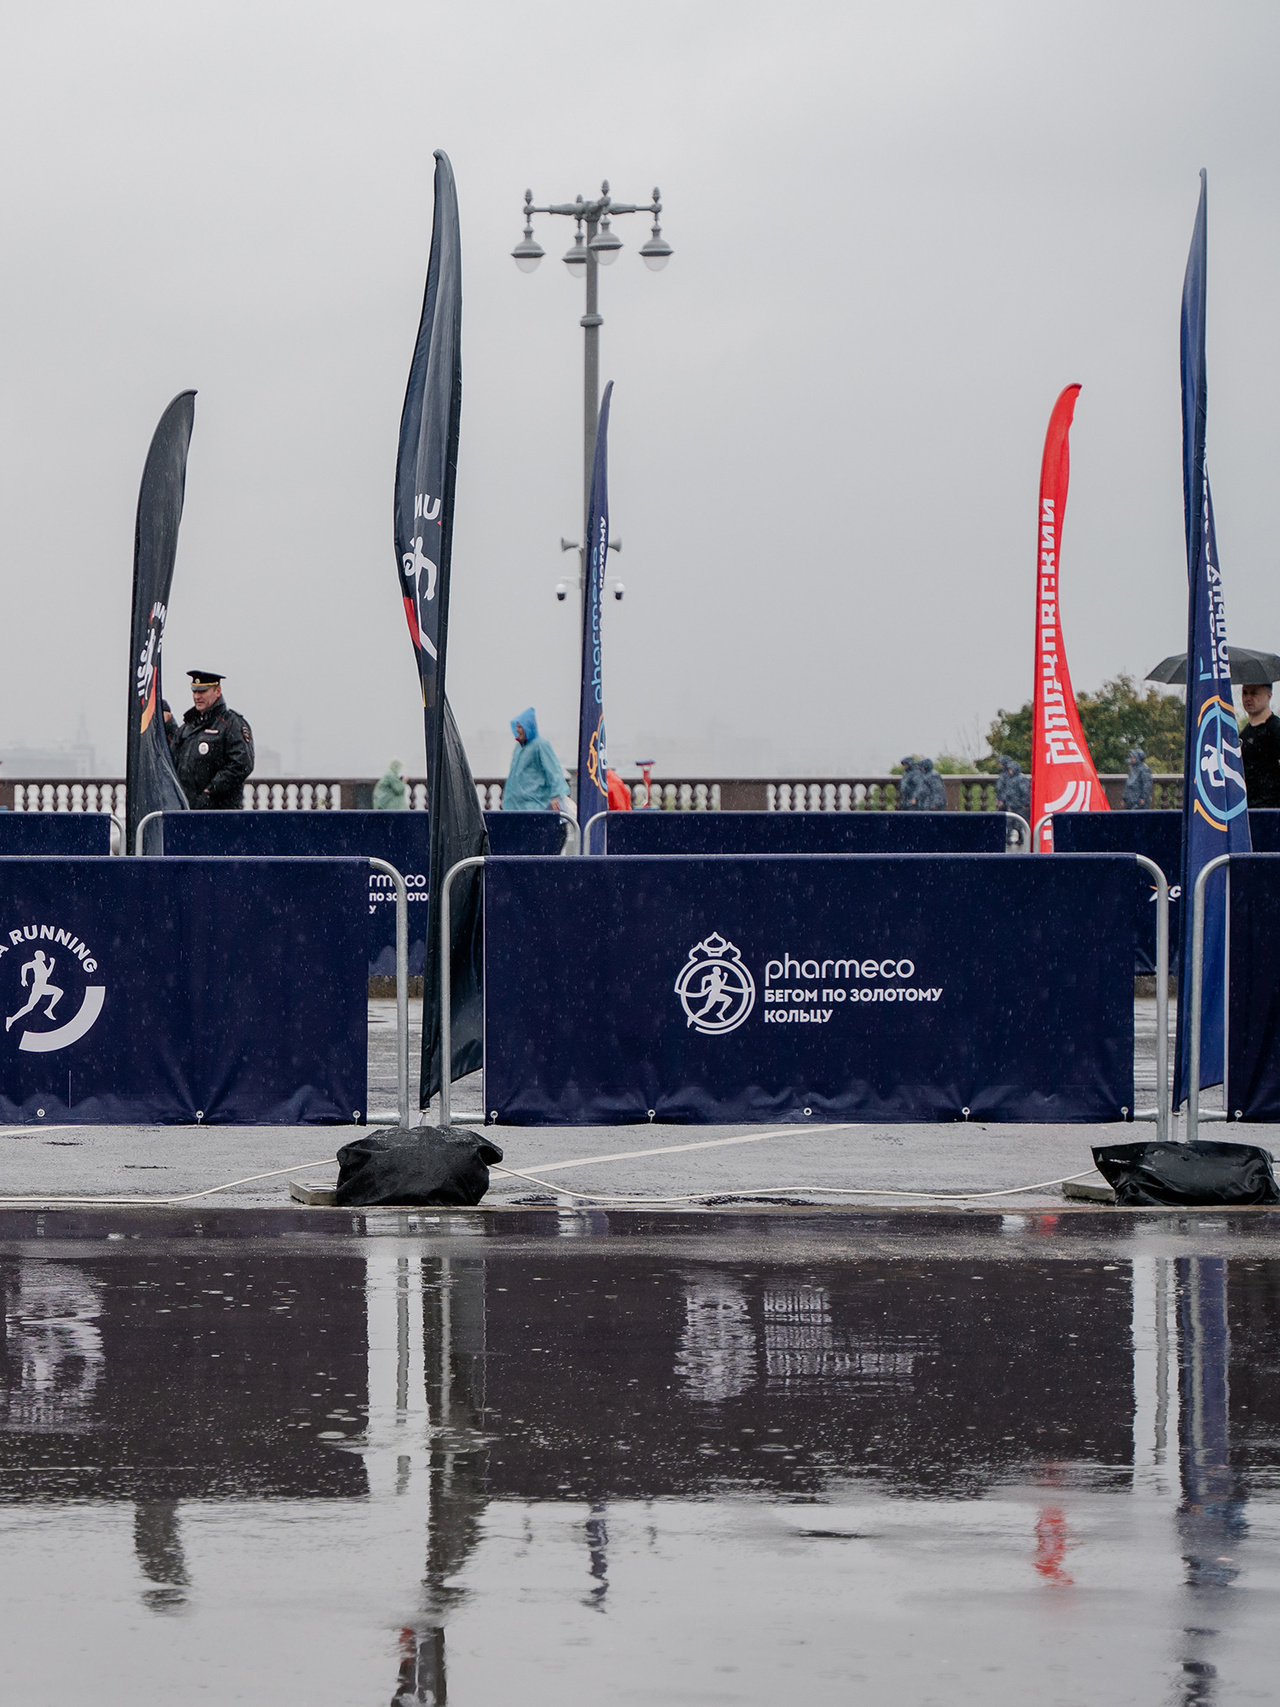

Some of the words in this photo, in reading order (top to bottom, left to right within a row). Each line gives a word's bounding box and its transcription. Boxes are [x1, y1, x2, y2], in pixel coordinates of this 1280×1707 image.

[8, 924, 98, 973] RUNNING
[764, 952, 915, 987] pharmeco
[764, 989, 818, 1003] БЕГОМ
[822, 988, 847, 1002] ПО
[850, 988, 943, 1002] ЗОЛОТОМУ
[764, 1009, 834, 1024] КОЛЬЦУ
